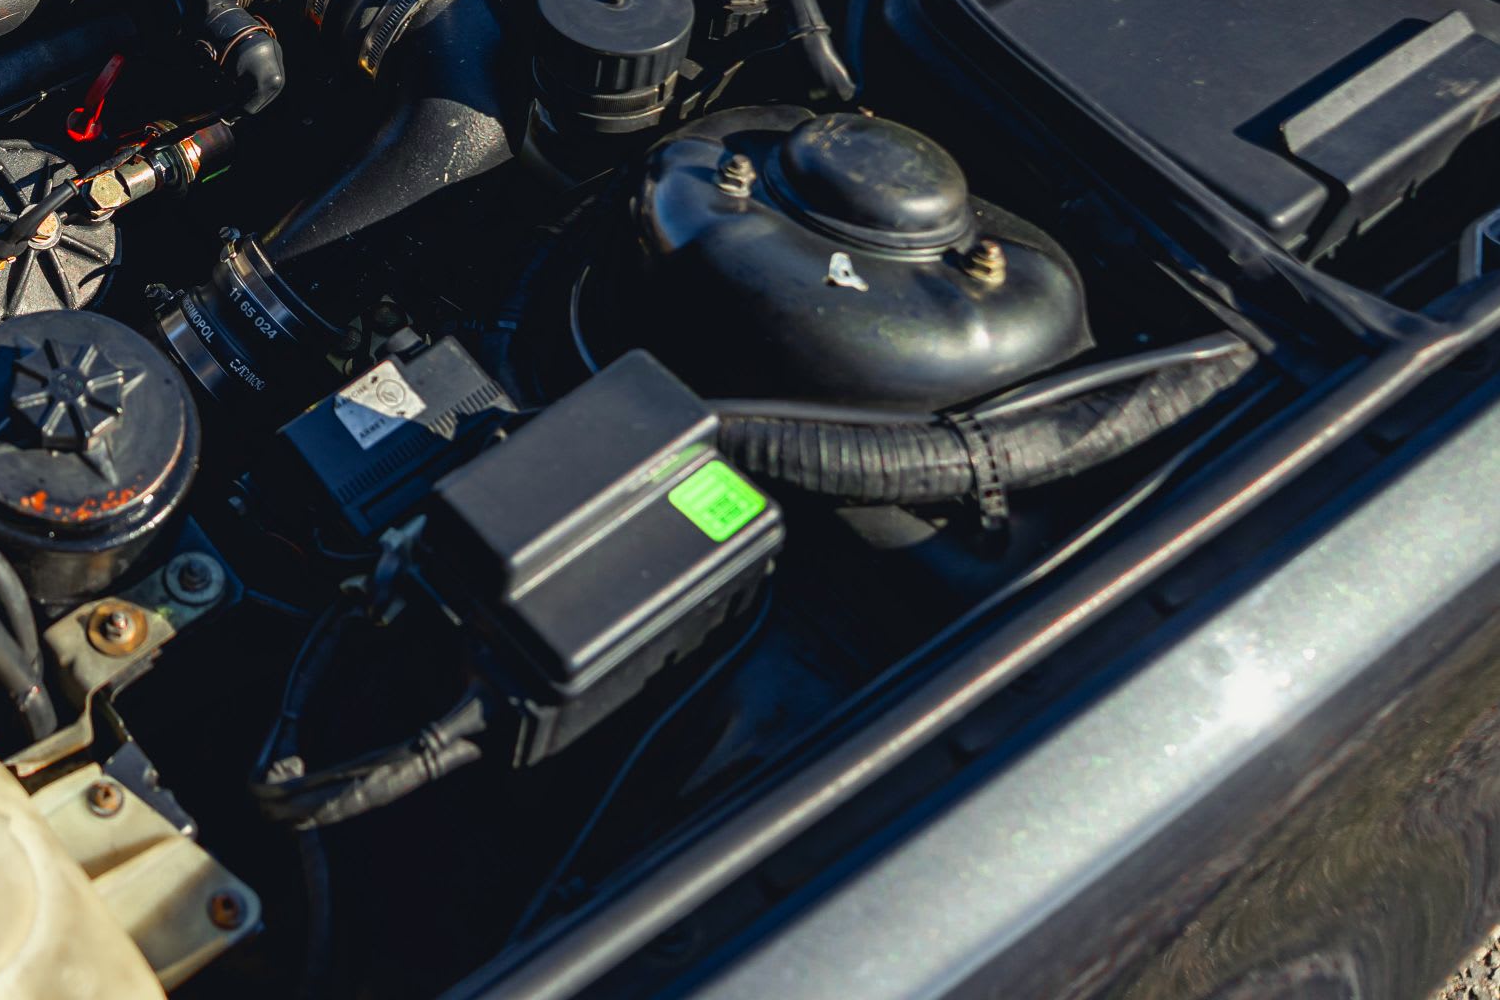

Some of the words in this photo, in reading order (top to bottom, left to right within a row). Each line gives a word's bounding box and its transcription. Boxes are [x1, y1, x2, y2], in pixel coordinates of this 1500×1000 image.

[229, 287, 242, 302] 11
[240, 300, 257, 318] 65
[254, 316, 278, 339] 024
